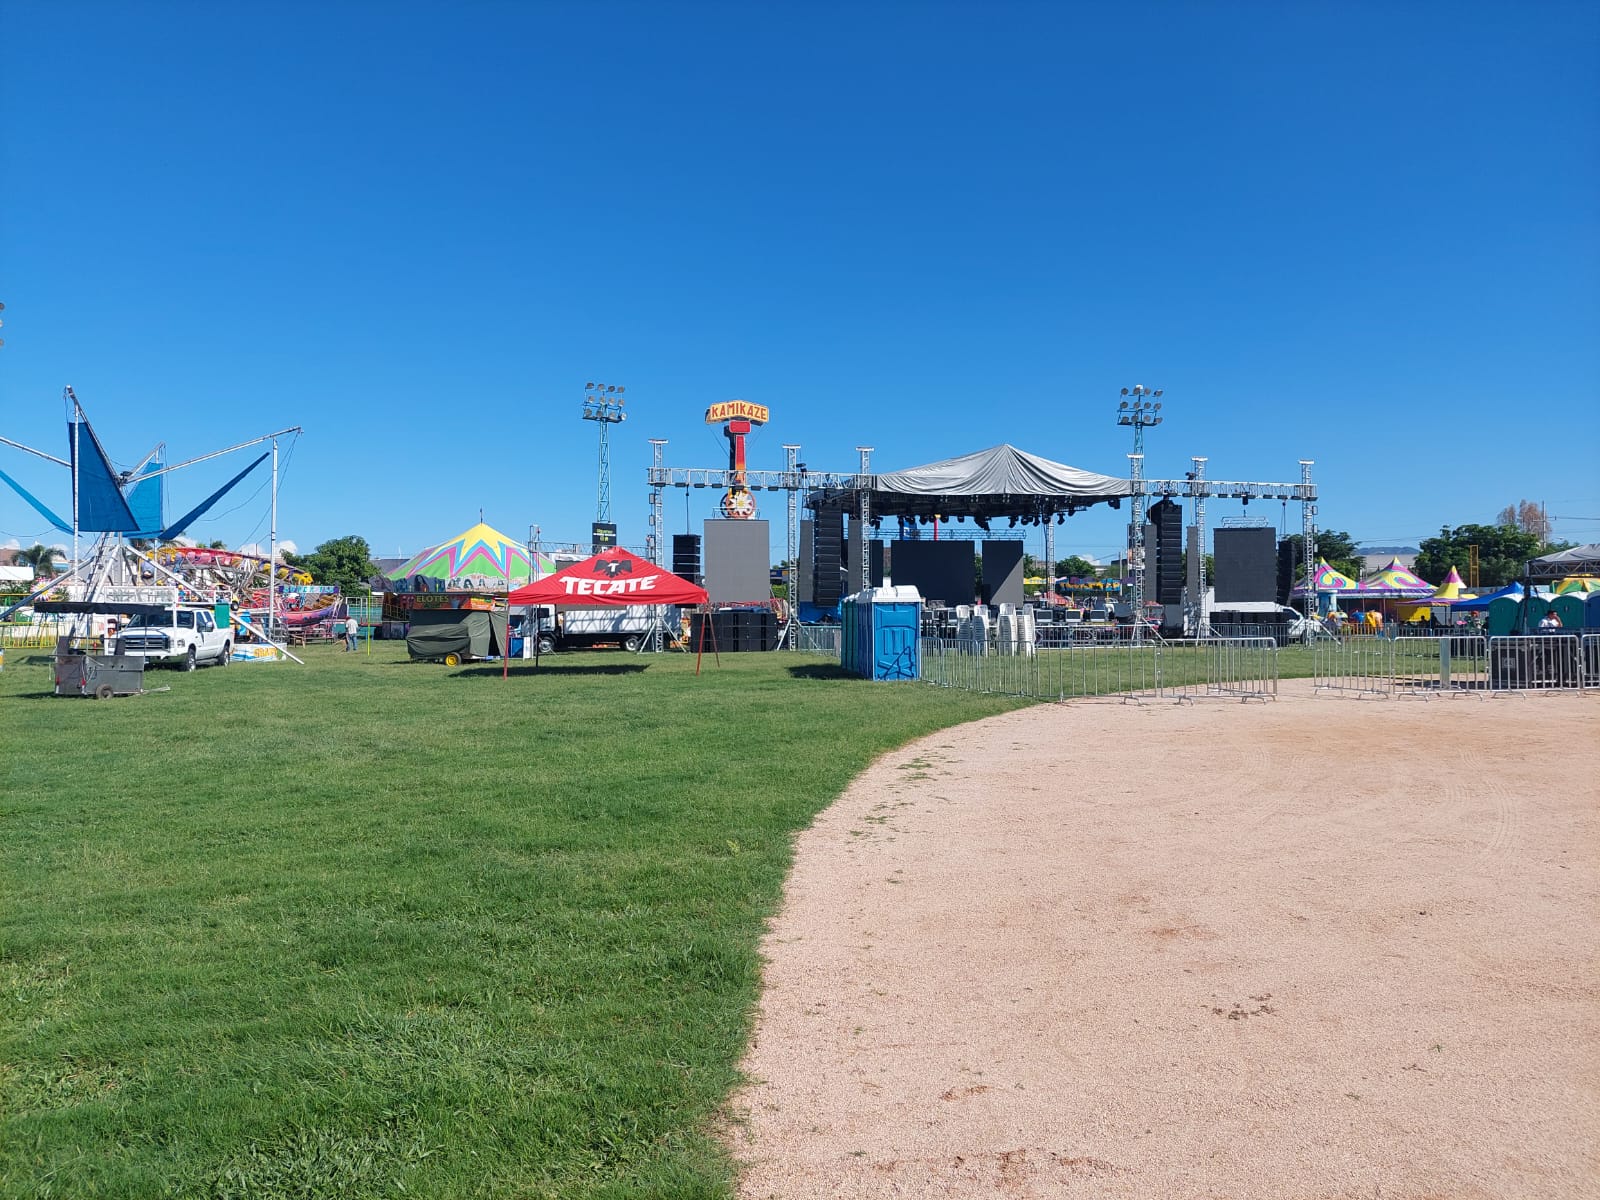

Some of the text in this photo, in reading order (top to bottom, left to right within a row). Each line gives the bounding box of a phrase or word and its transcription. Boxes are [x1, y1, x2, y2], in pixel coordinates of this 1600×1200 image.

[711, 402, 767, 421] KAMIKAZE
[559, 575, 662, 595] TECATE
[416, 595, 449, 603] ELOTES
